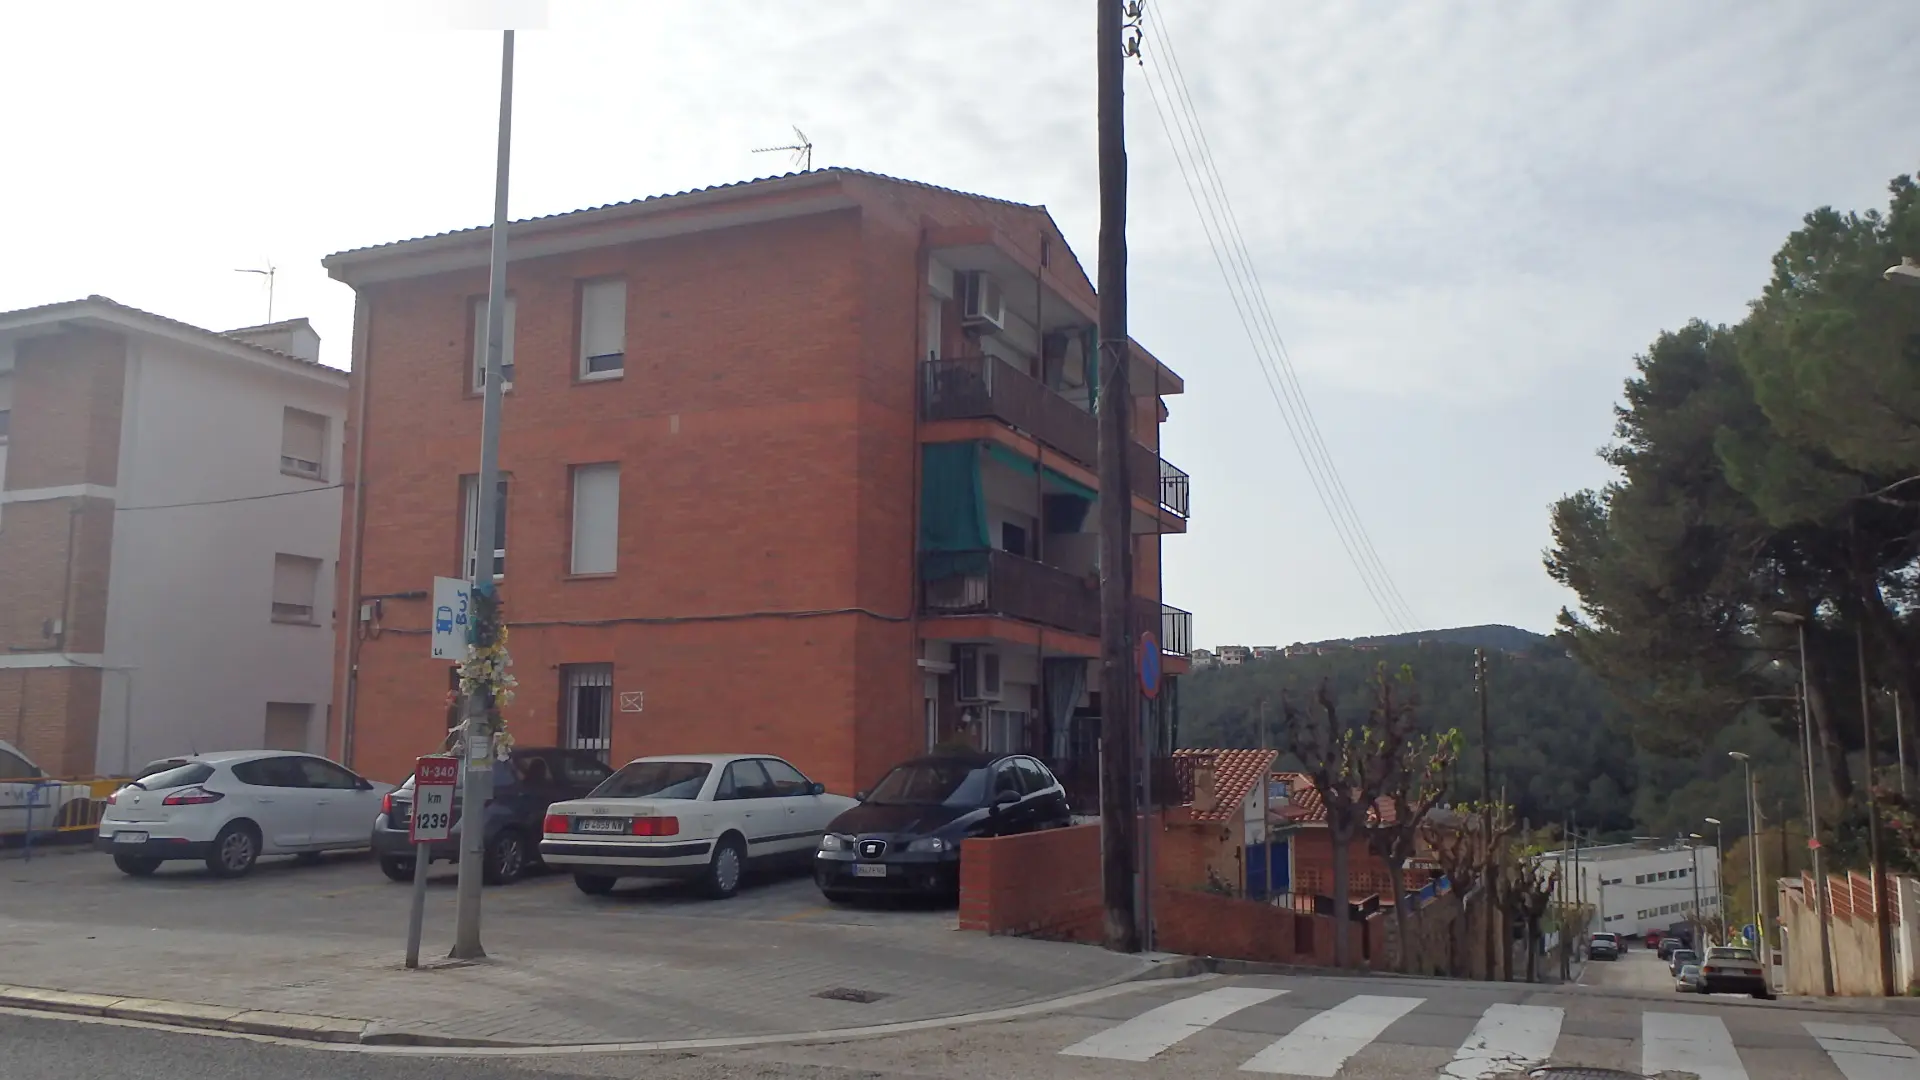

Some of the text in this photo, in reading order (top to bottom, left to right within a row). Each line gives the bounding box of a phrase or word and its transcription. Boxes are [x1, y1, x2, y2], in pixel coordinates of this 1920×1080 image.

[421, 765, 455, 778] N-340
[427, 791, 442, 804] km
[416, 813, 449, 829] 1239
